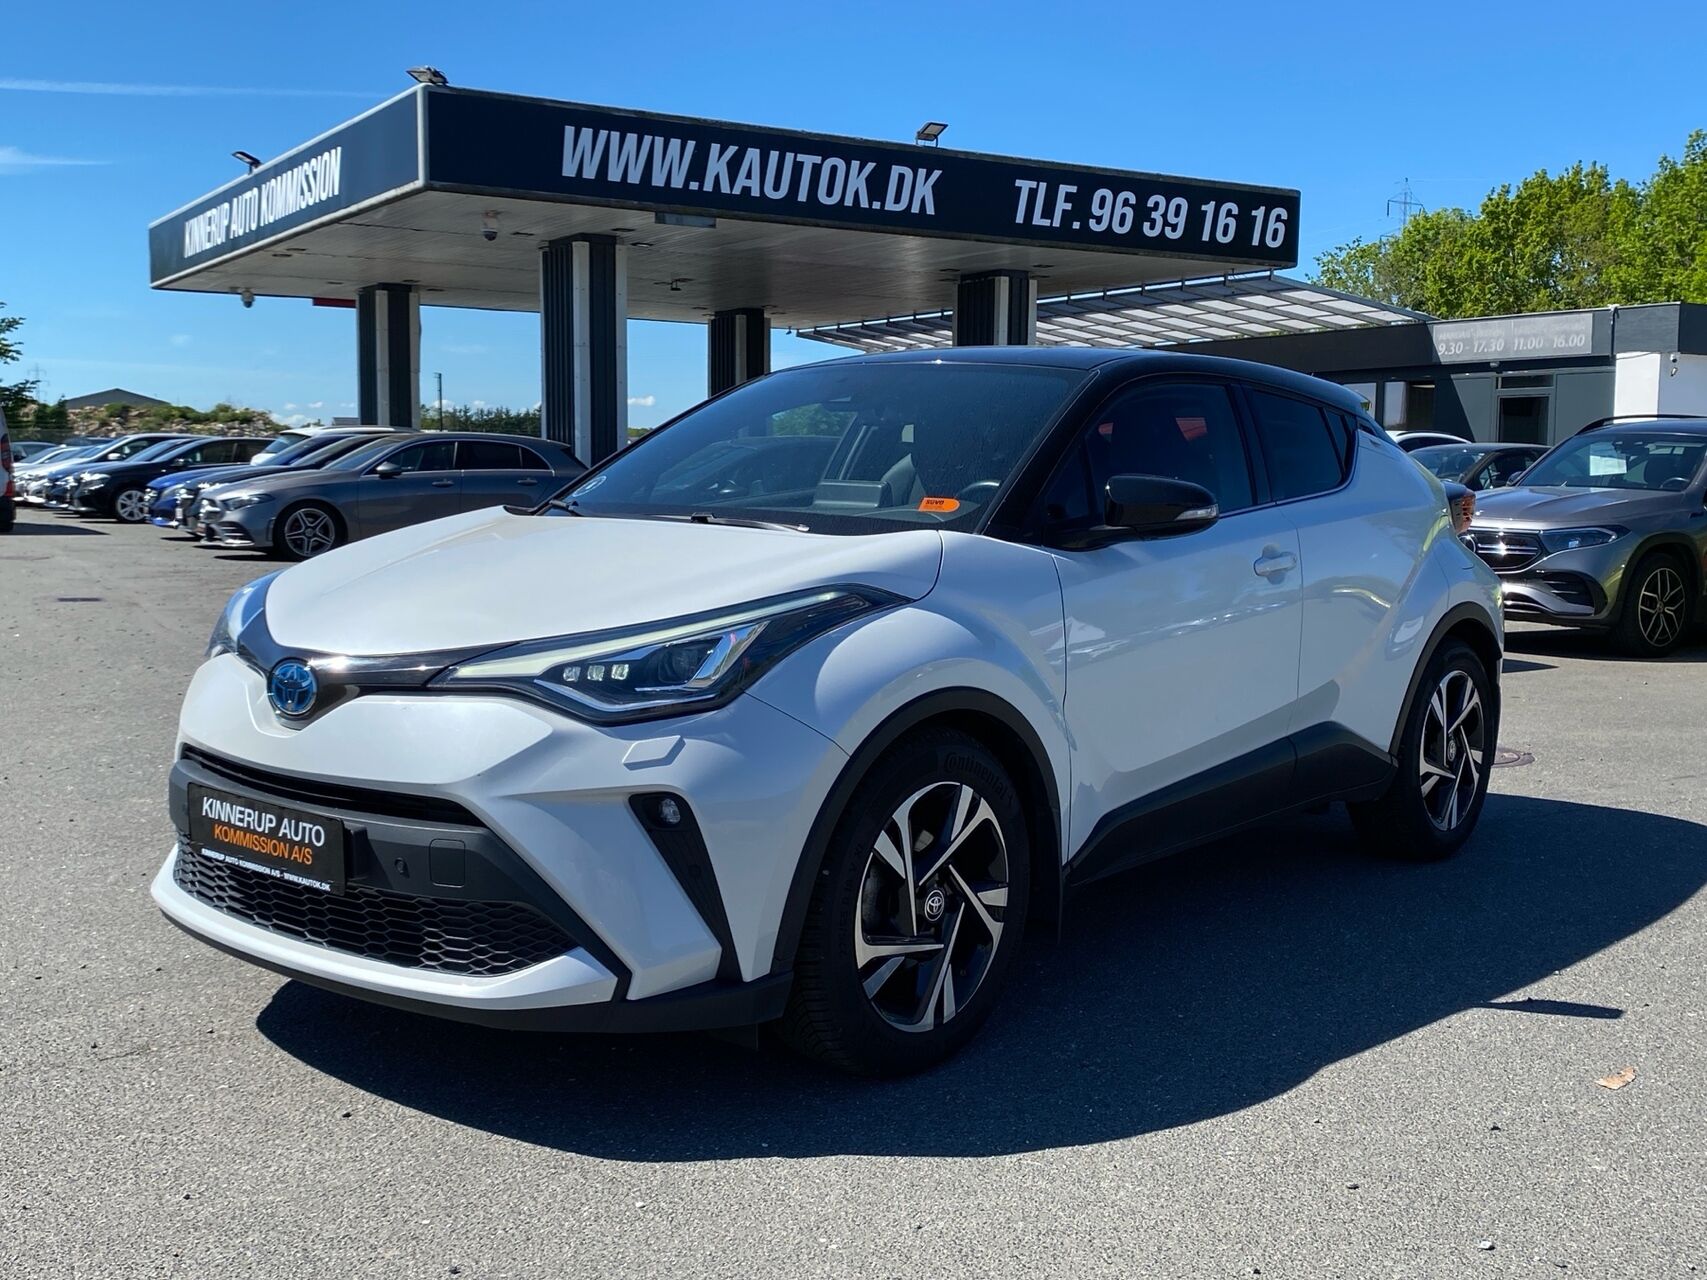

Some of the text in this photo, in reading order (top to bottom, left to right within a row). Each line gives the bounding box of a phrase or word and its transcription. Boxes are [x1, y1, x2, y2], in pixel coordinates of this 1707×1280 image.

[561, 125, 943, 216] WWW.KAUTOK.DK
[183, 146, 342, 258] KINNERUP AUTO KOMMISSION
[1014, 180, 1288, 248] TLF. 96 39 16 16
[1438, 341, 1464, 356] 9.30
[1473, 338, 1505, 353] 17.30
[1513, 334, 1585, 351] 11.00 16.00
[943, 751, 1009, 801] Continental
[202, 796, 325, 847] KINNERUP AUTO
[214, 823, 313, 865] KOMMISSION A/S
